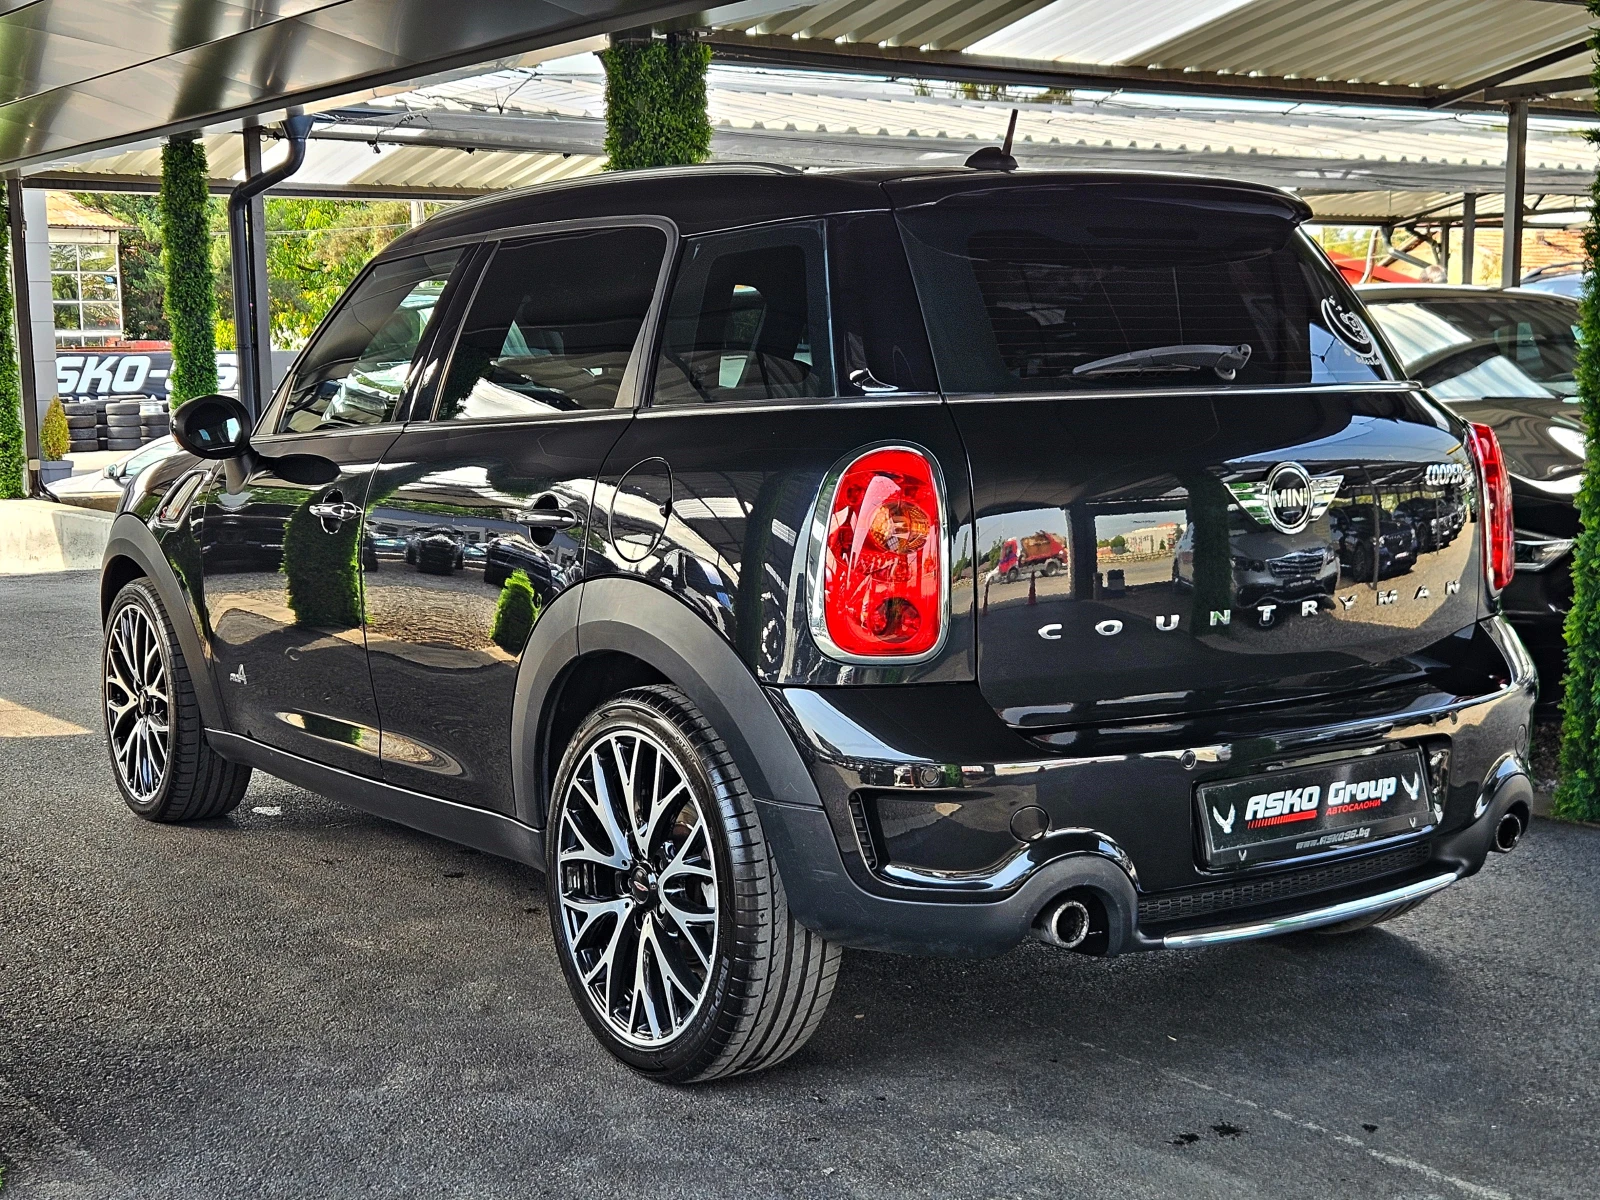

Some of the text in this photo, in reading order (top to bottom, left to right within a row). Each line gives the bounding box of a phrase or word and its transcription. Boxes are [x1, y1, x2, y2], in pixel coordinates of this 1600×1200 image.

[1425, 464, 1463, 486] COOPER
[1271, 488, 1308, 508] MINI
[1037, 580, 1460, 640] COUNTRYMAN
[1245, 776, 1397, 821] ASKO Group
[1325, 799, 1381, 816] АВТОСАЛОНИ
